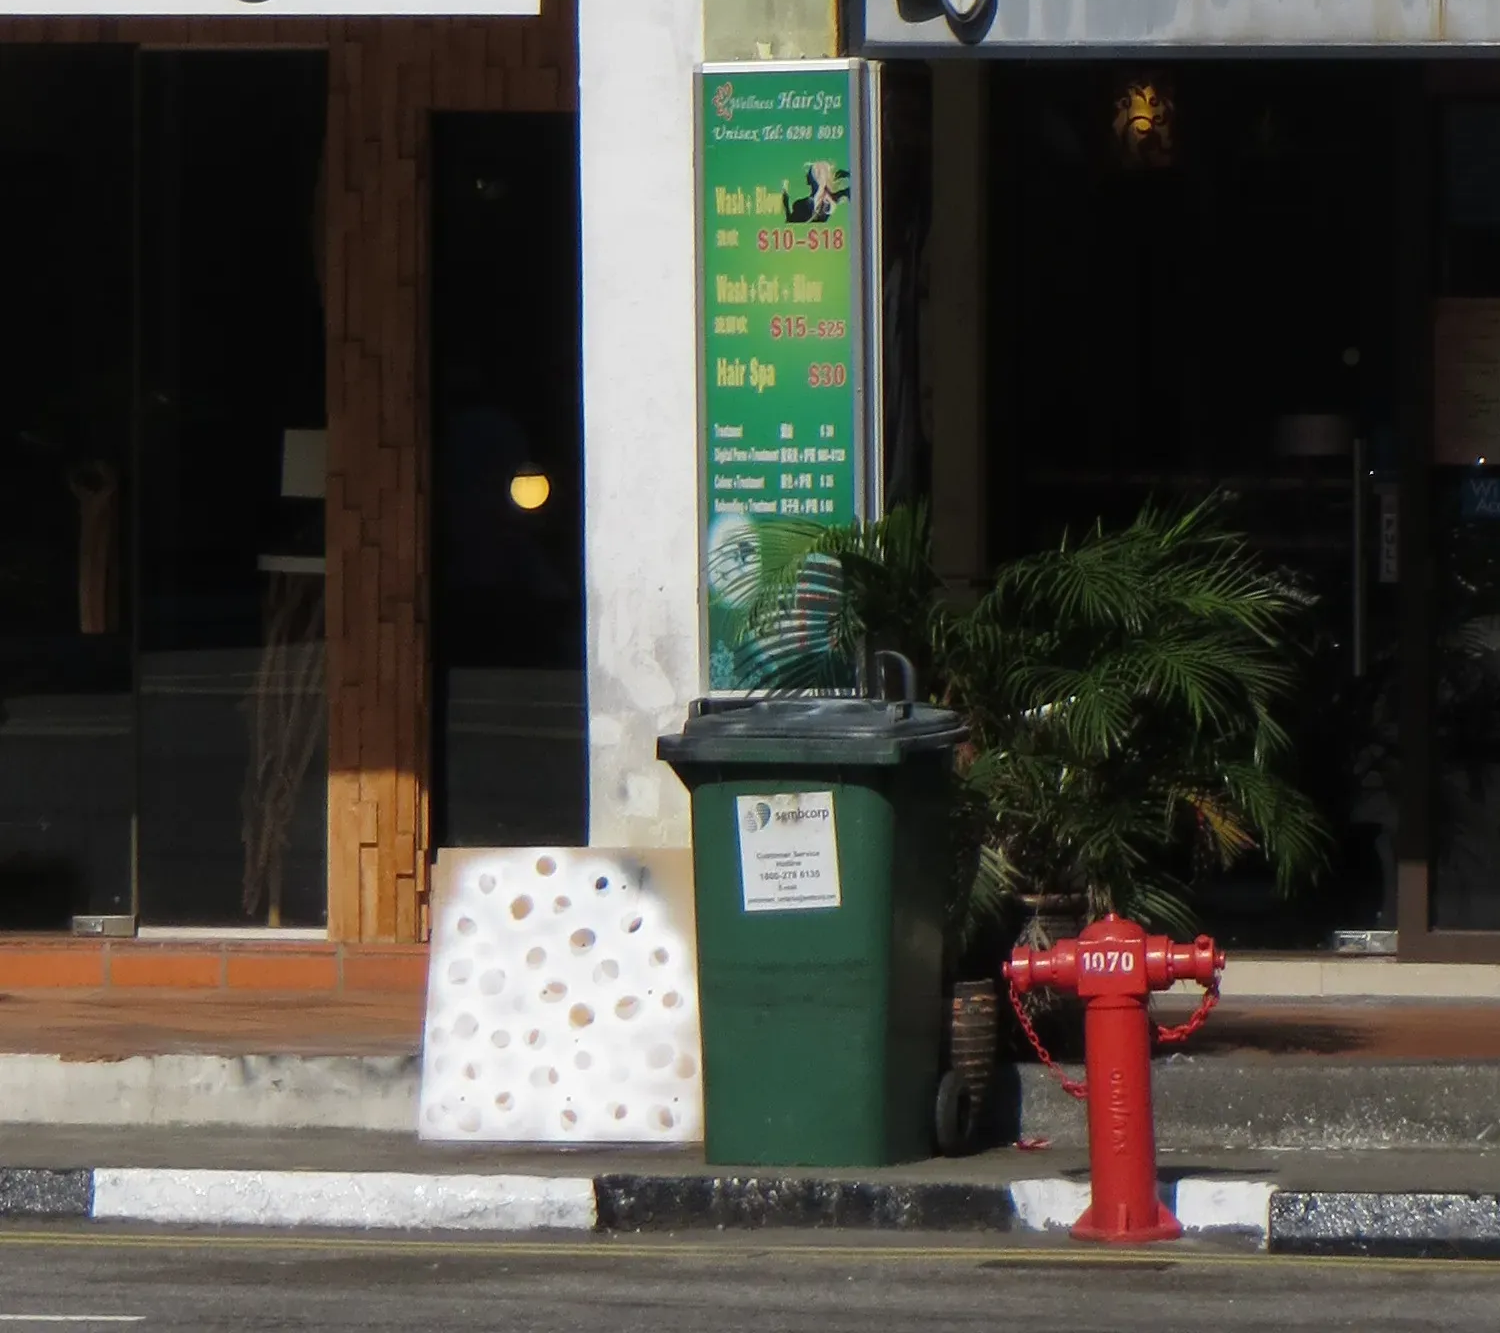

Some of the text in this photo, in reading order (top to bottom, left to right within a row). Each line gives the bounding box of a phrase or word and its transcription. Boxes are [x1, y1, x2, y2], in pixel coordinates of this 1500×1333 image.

[713, 124, 760, 142] Unisex
[717, 356, 776, 394] Hair Spa
[808, 362, 847, 388] $30
[1082, 951, 1134, 972] 1070
